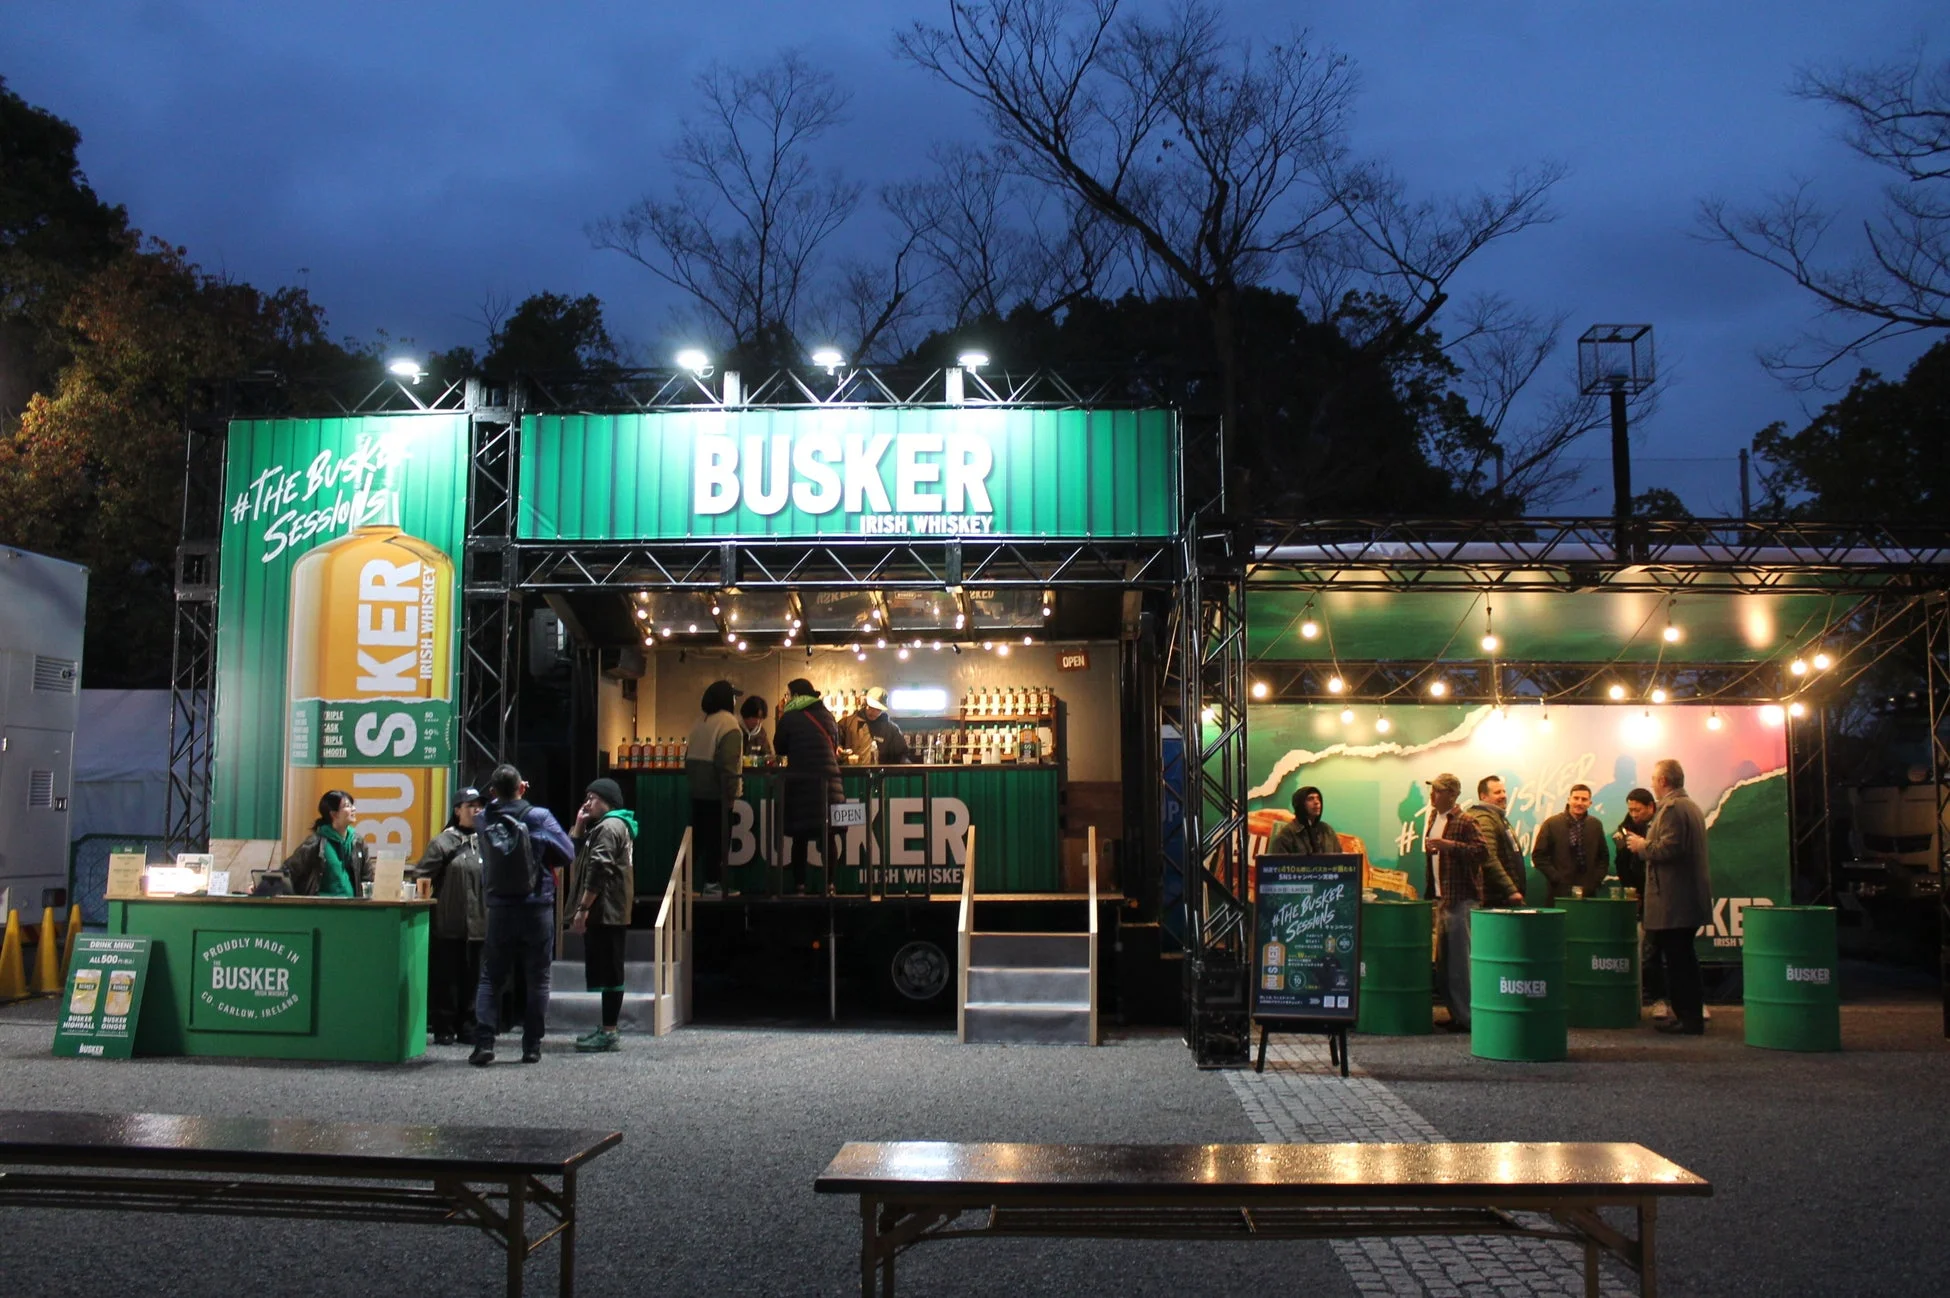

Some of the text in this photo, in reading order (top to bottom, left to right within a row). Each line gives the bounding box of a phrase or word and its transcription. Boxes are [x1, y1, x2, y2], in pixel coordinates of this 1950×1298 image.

[694, 433, 994, 515] BUSKER
[231, 465, 301, 525] #THE
[860, 516, 993, 534] IRISH WHISKEY
[420, 564, 436, 680] IRISH WHISKEY
[1062, 655, 1085, 668] OPEN
[833, 807, 863, 823] OPEN
[1271, 884, 1344, 928] #THE BUSKER
[1285, 903, 1336, 943] SESSIONS
[90, 941, 135, 950] DRINK MENU
[1713, 937, 1737, 947] IRISH
[203, 938, 300, 964] PROUDLY MADE IN
[89, 956, 101, 964] ALL
[1591, 958, 1630, 970] BUSKER
[212, 966, 289, 990] BUSKER
[1786, 967, 1830, 981] BUSKER
[1500, 980, 1547, 994] BUSKER
[201, 990, 299, 1019] CO. CARLOW, IRELAND
[103, 1016, 127, 1024] BUSKER
[79, 1044, 104, 1054] BUSKER
